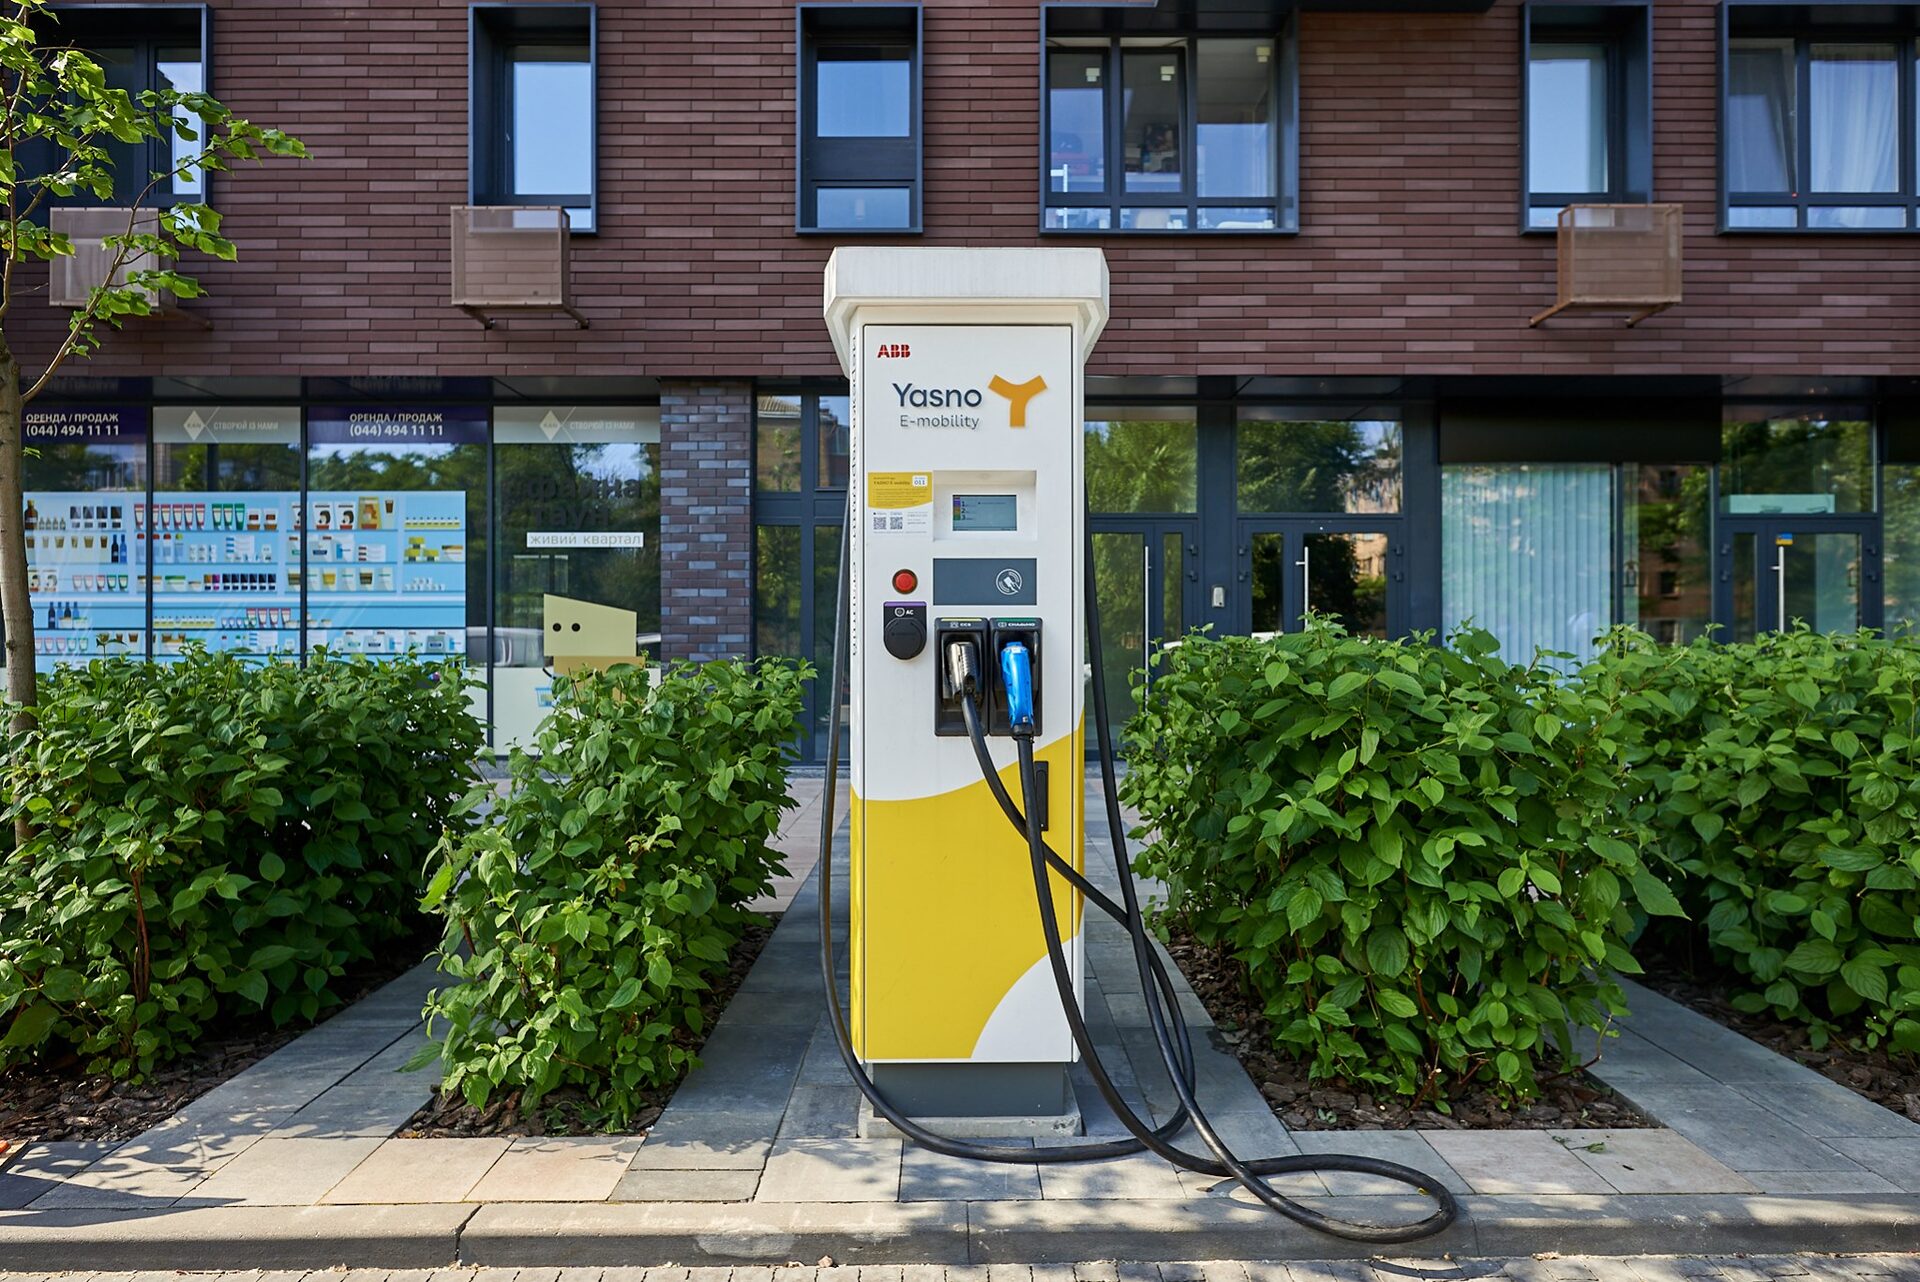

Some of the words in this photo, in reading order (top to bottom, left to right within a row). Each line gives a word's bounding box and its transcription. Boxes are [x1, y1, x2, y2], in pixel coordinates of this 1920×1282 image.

[877, 344, 911, 358] ABB
[892, 383, 982, 407] Yasno
[26, 413, 66, 424] ОРЕНДА
[75, 413, 118, 424] ПРОДАЖ
[349, 413, 391, 424] ОРЕНДА
[398, 413, 442, 424] ПРОДАЖ
[900, 414, 980, 430] E-mobility
[26, 425, 58, 437] (044)
[61, 425, 84, 436] 494
[88, 425, 101, 436] 11
[106, 425, 119, 436] 11
[350, 425, 381, 437] (044)
[384, 425, 408, 436] 494
[411, 425, 425, 436] 11
[429, 425, 443, 436] 11
[530, 533, 577, 545] живий
[583, 534, 641, 547] квартал
